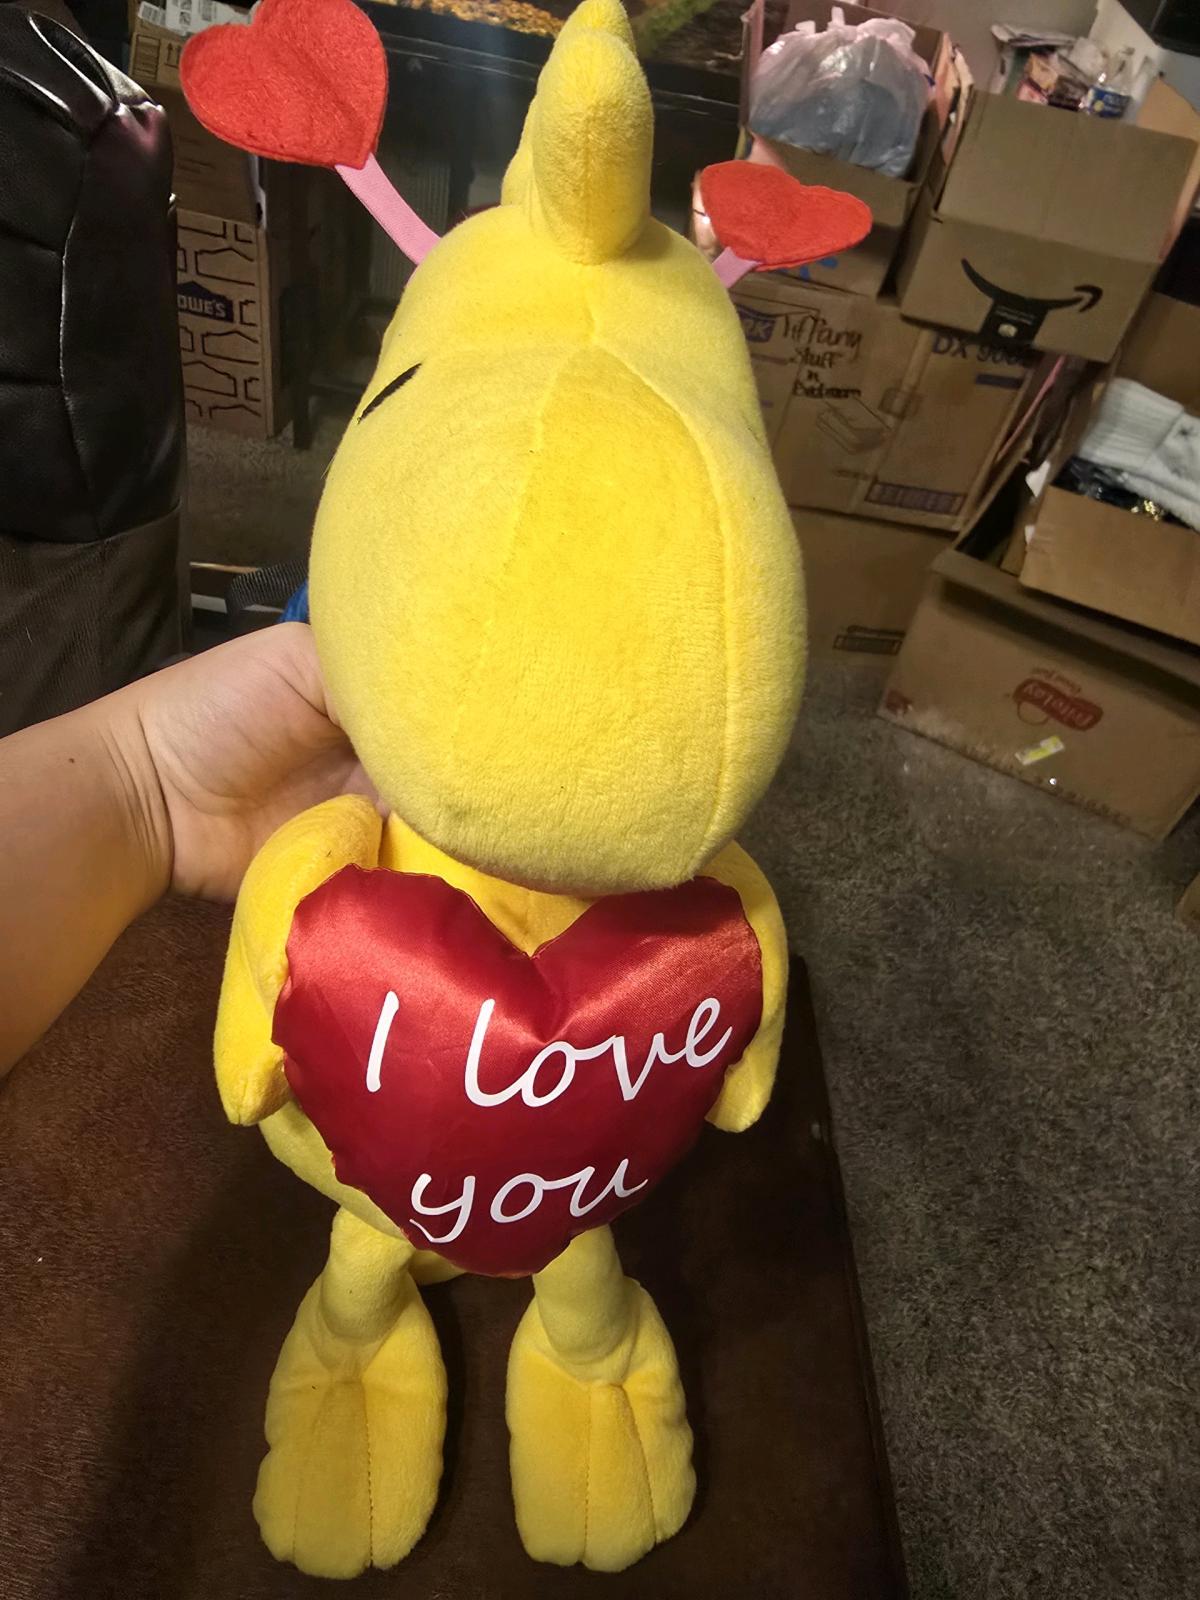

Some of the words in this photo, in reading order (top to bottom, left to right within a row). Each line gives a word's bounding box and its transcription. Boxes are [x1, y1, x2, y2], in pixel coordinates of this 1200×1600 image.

[177, 293, 227, 319] OWE'S
[781, 313, 864, 364] Tiffany
[366, 991, 400, 1093] I
[409, 1158, 649, 1244] you
